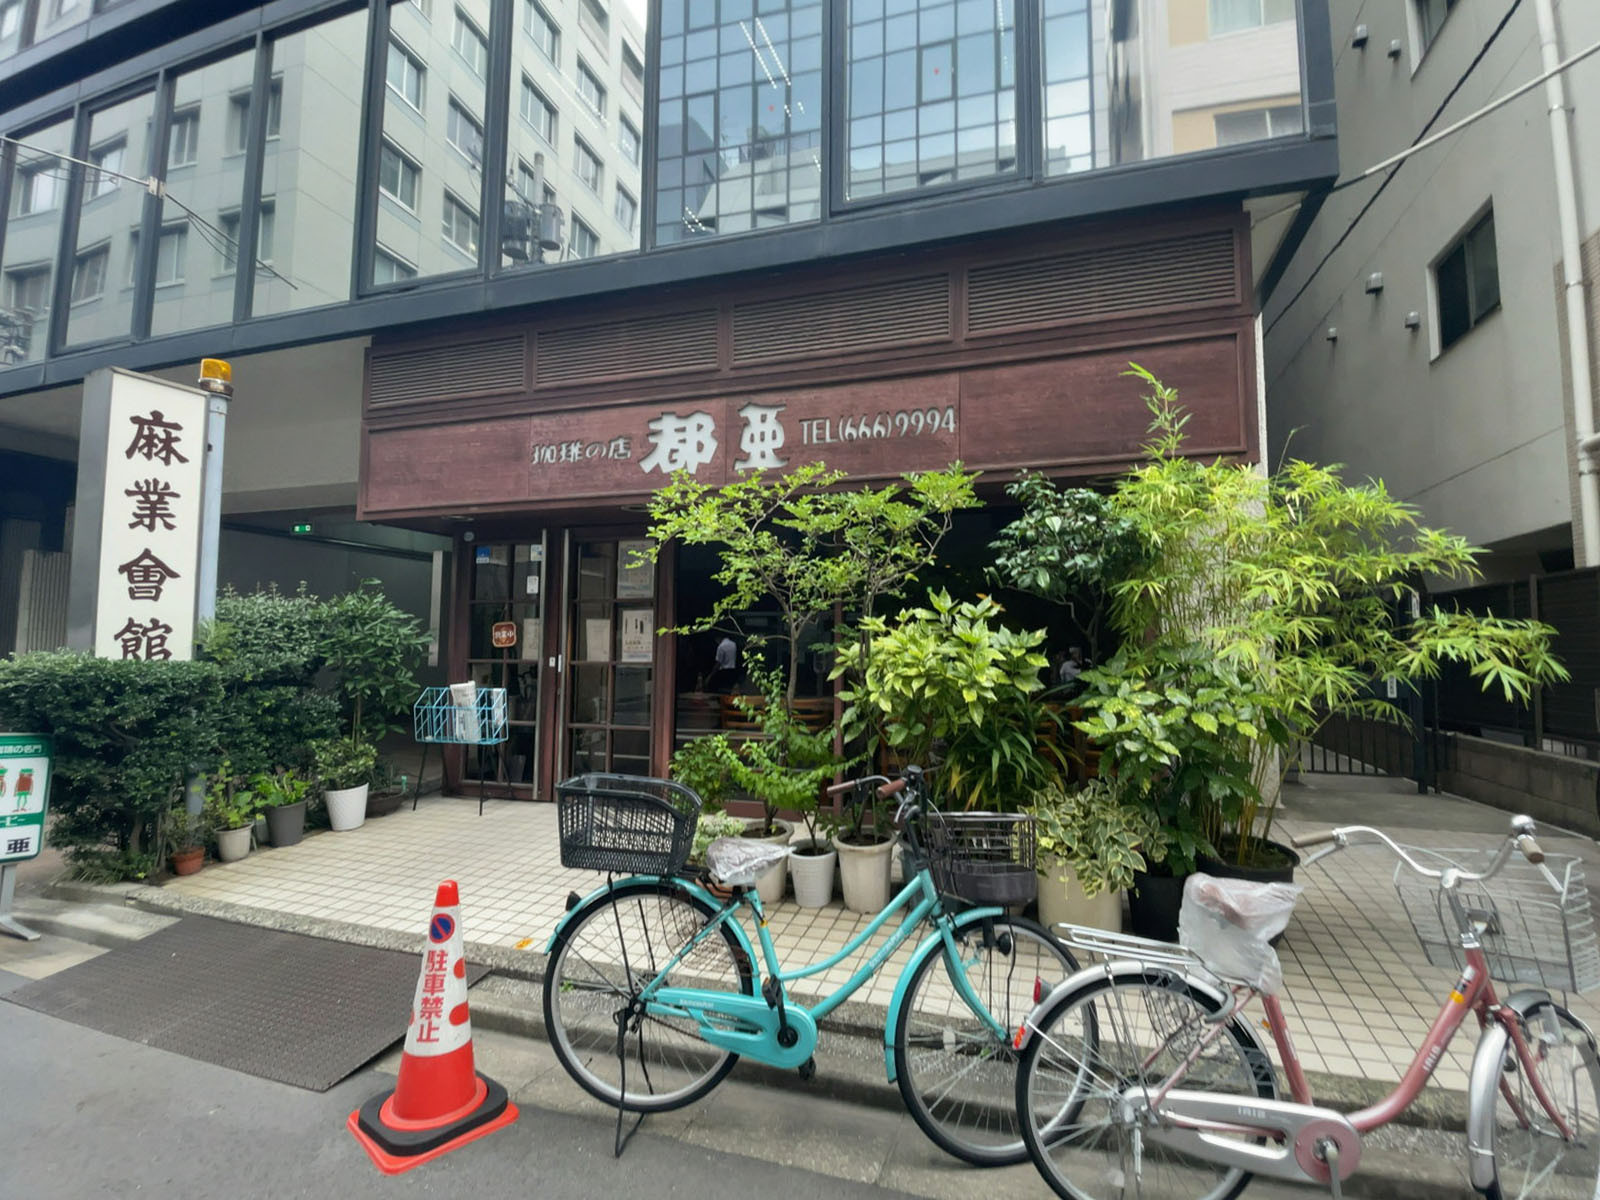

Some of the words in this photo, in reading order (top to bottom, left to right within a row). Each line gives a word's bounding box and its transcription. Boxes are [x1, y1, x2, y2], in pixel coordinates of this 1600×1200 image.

[531, 436, 632, 464] 珈琲の店
[114, 410, 190, 661] 麻業會館
[416, 949, 449, 1043] 駐車禁止
